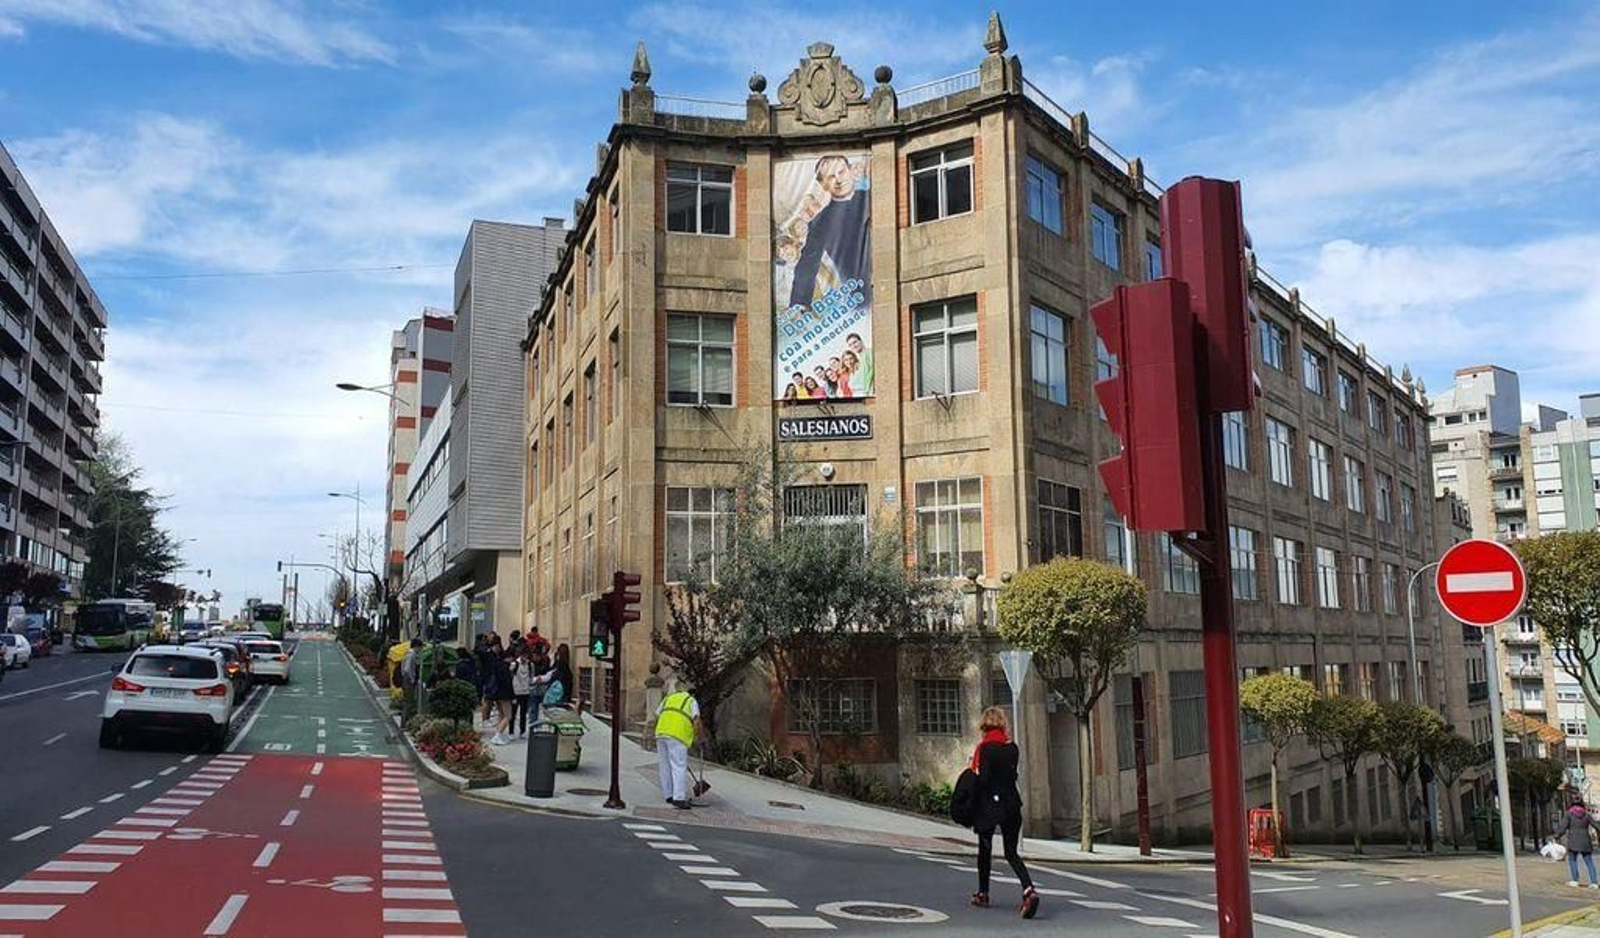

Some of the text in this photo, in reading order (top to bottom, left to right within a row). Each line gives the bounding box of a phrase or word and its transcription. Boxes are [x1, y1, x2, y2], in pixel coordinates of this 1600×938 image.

[779, 291, 865, 362] coa mocidade
[783, 312, 813, 337] Don
[784, 365, 791, 373] e
[791, 349, 813, 369] para
[820, 309, 867, 346] mocidade
[780, 418, 869, 437] SALESIANOS
